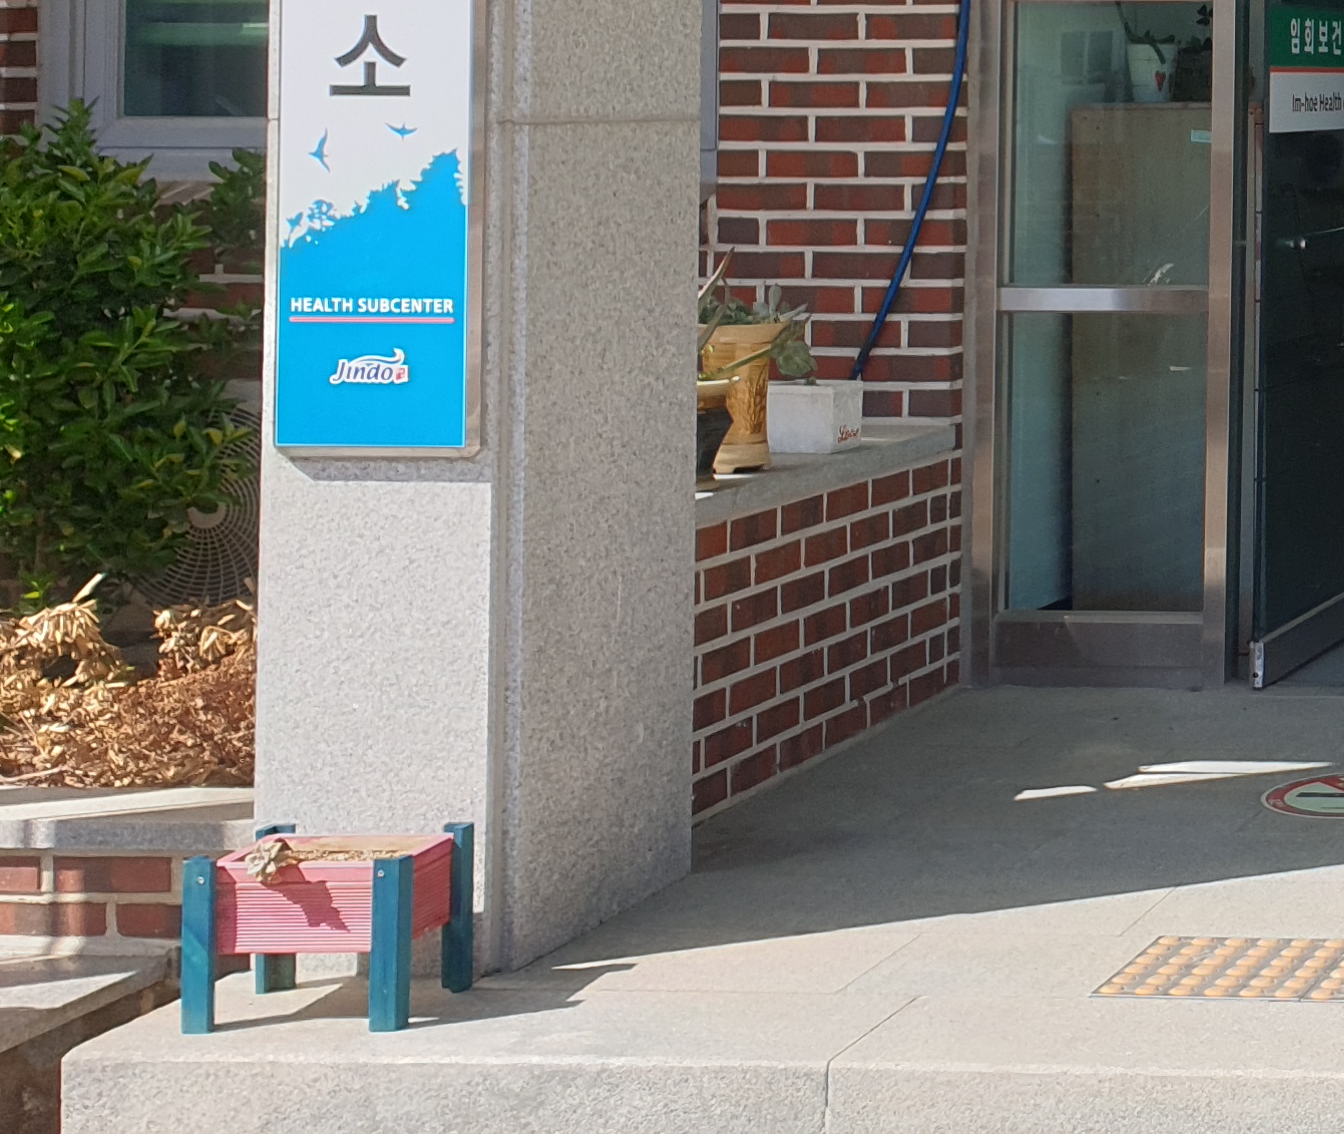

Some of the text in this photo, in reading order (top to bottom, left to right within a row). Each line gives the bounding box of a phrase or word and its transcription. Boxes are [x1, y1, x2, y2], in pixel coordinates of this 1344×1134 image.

[1292, 92, 1318, 113] Im-hoe
[1319, 91, 1342, 112] Health
[290, 296, 454, 314] HEALTH SUBCENTER
